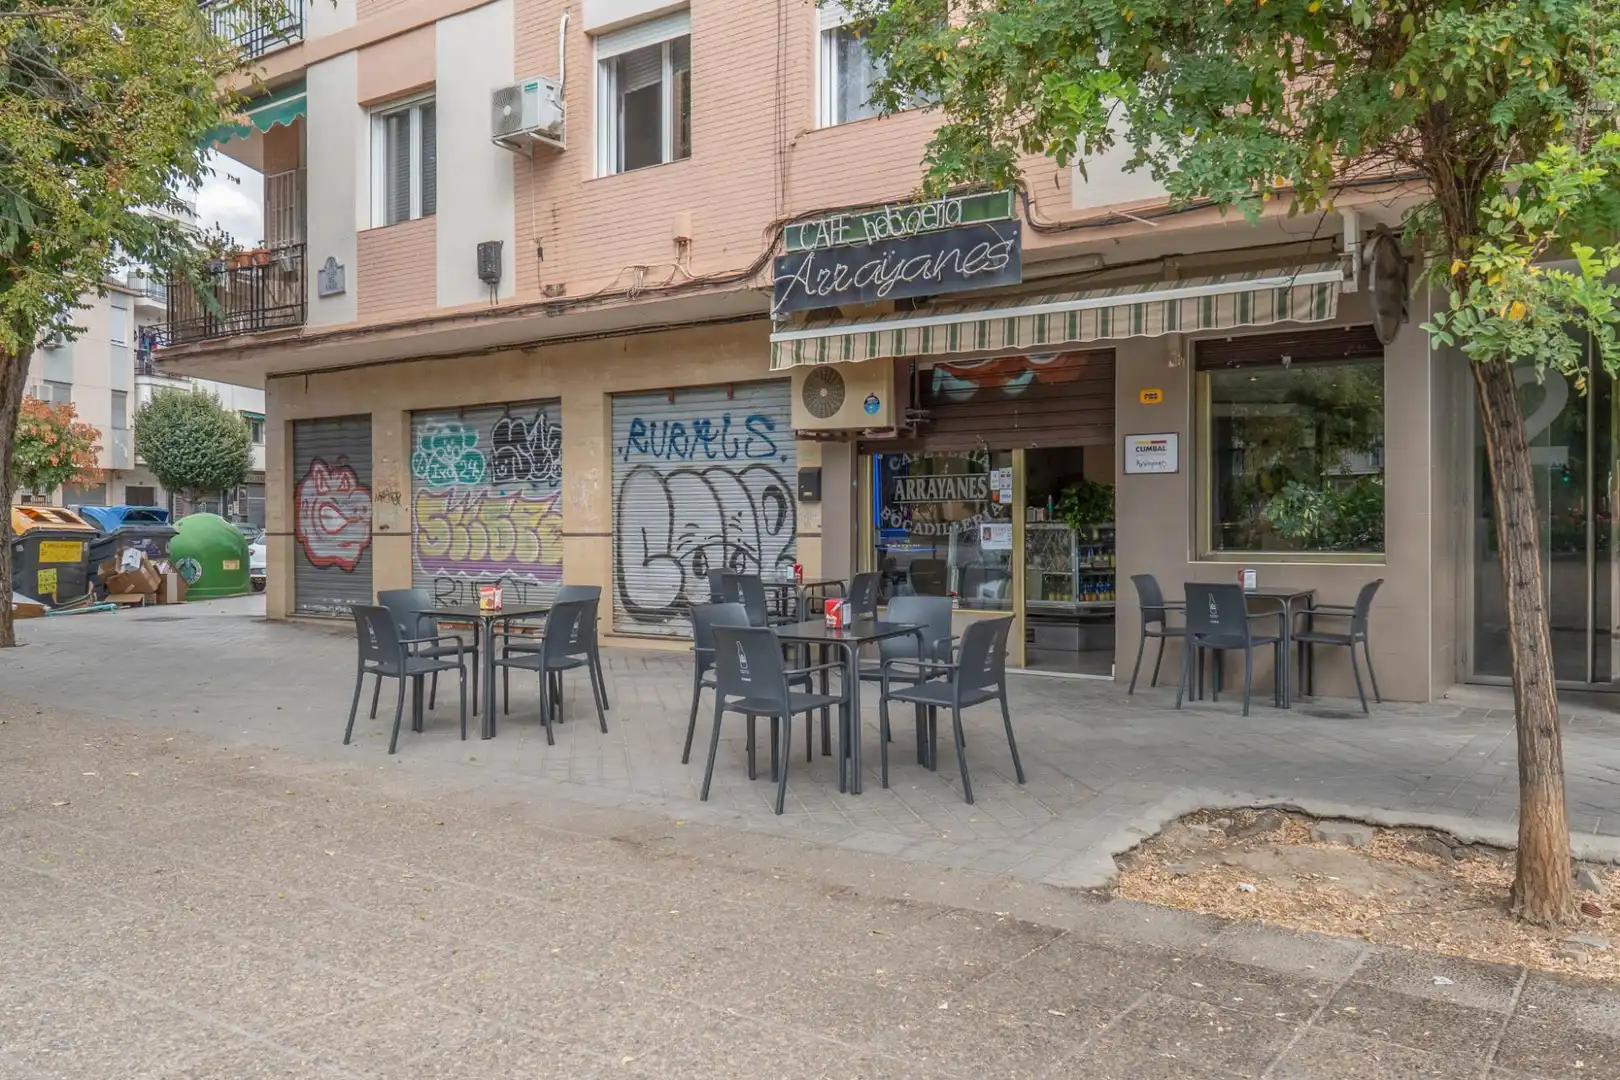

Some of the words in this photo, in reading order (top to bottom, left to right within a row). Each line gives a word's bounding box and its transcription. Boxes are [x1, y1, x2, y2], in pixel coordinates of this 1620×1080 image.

[771, 238, 1015, 315] Arrayanes
[1513, 365, 1569, 465] 2
[1135, 445, 1167, 453] CUMBAL
[894, 476, 988, 501] ARRAYANES
